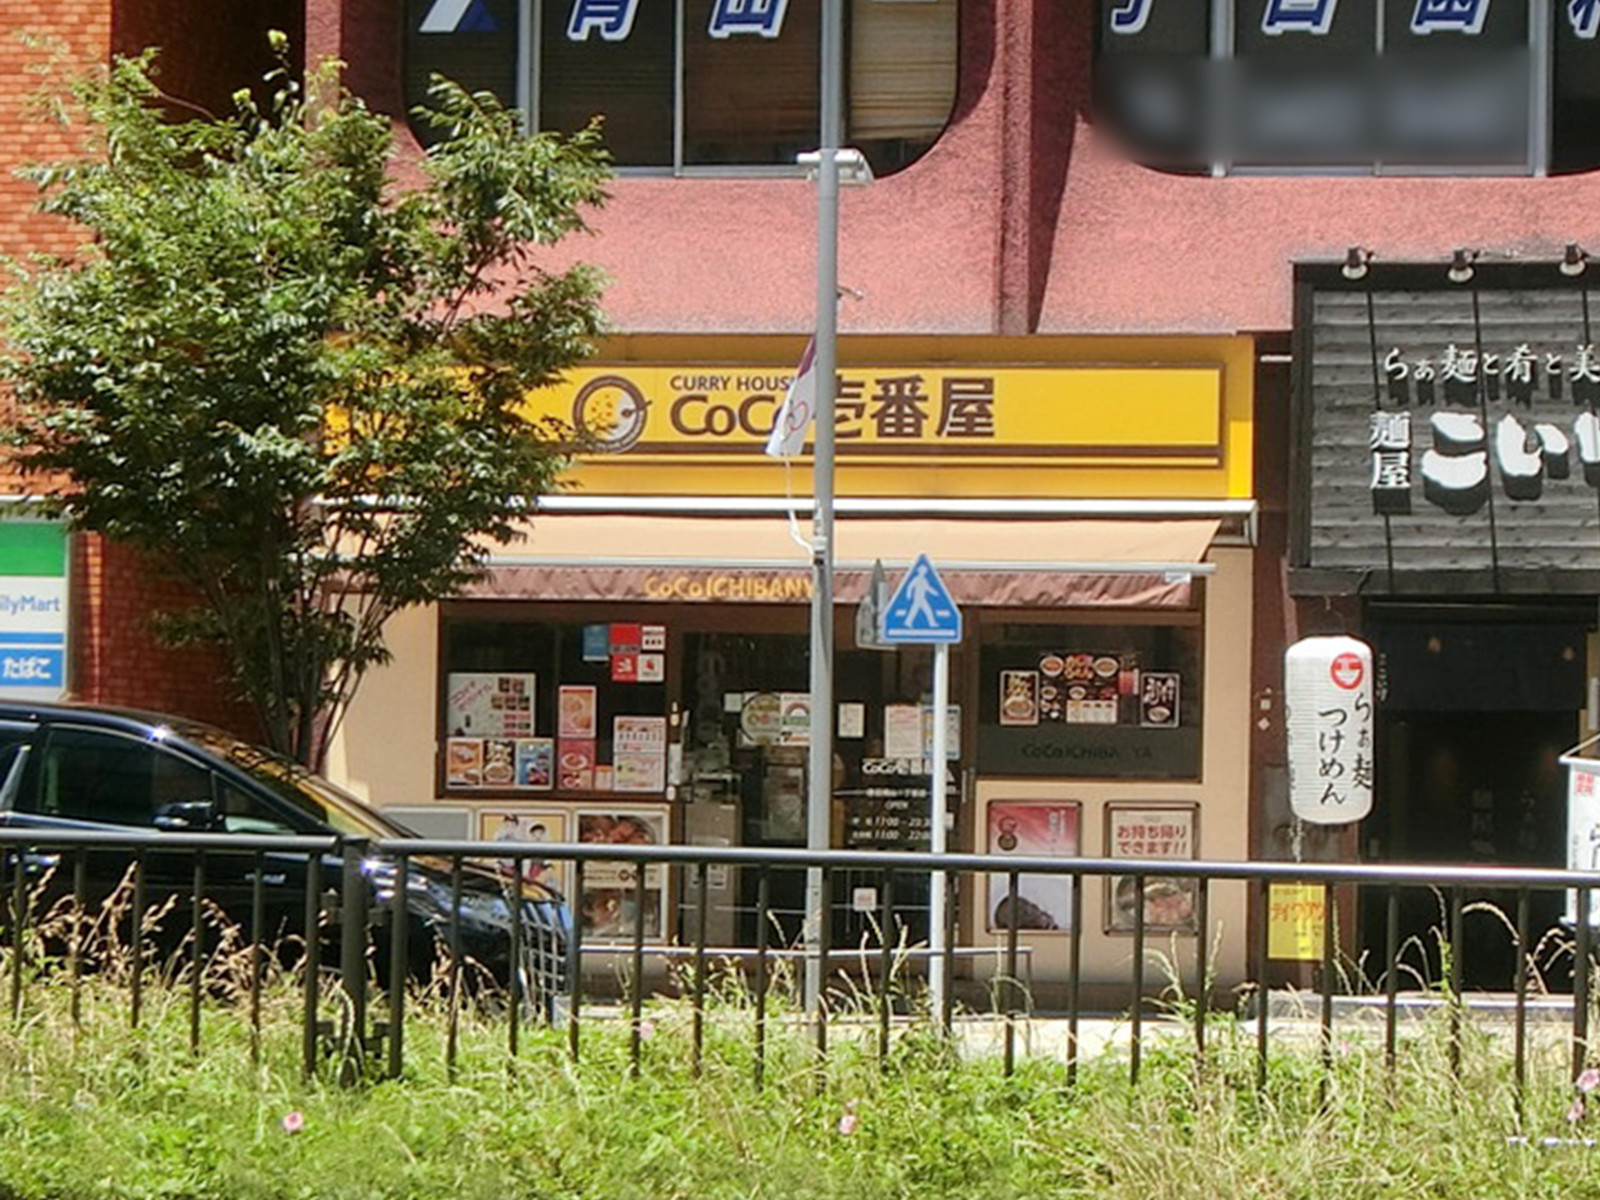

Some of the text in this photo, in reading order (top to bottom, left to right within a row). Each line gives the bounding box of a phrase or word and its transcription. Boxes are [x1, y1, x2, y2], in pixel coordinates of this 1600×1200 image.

[670, 375, 795, 391] CURRY HOUS
[1369, 411, 1412, 489] 麺屋
[3, 657, 52, 679] たばこ
[1318, 708, 1348, 805] つけめん
[1117, 825, 1187, 840] お持ち帰り
